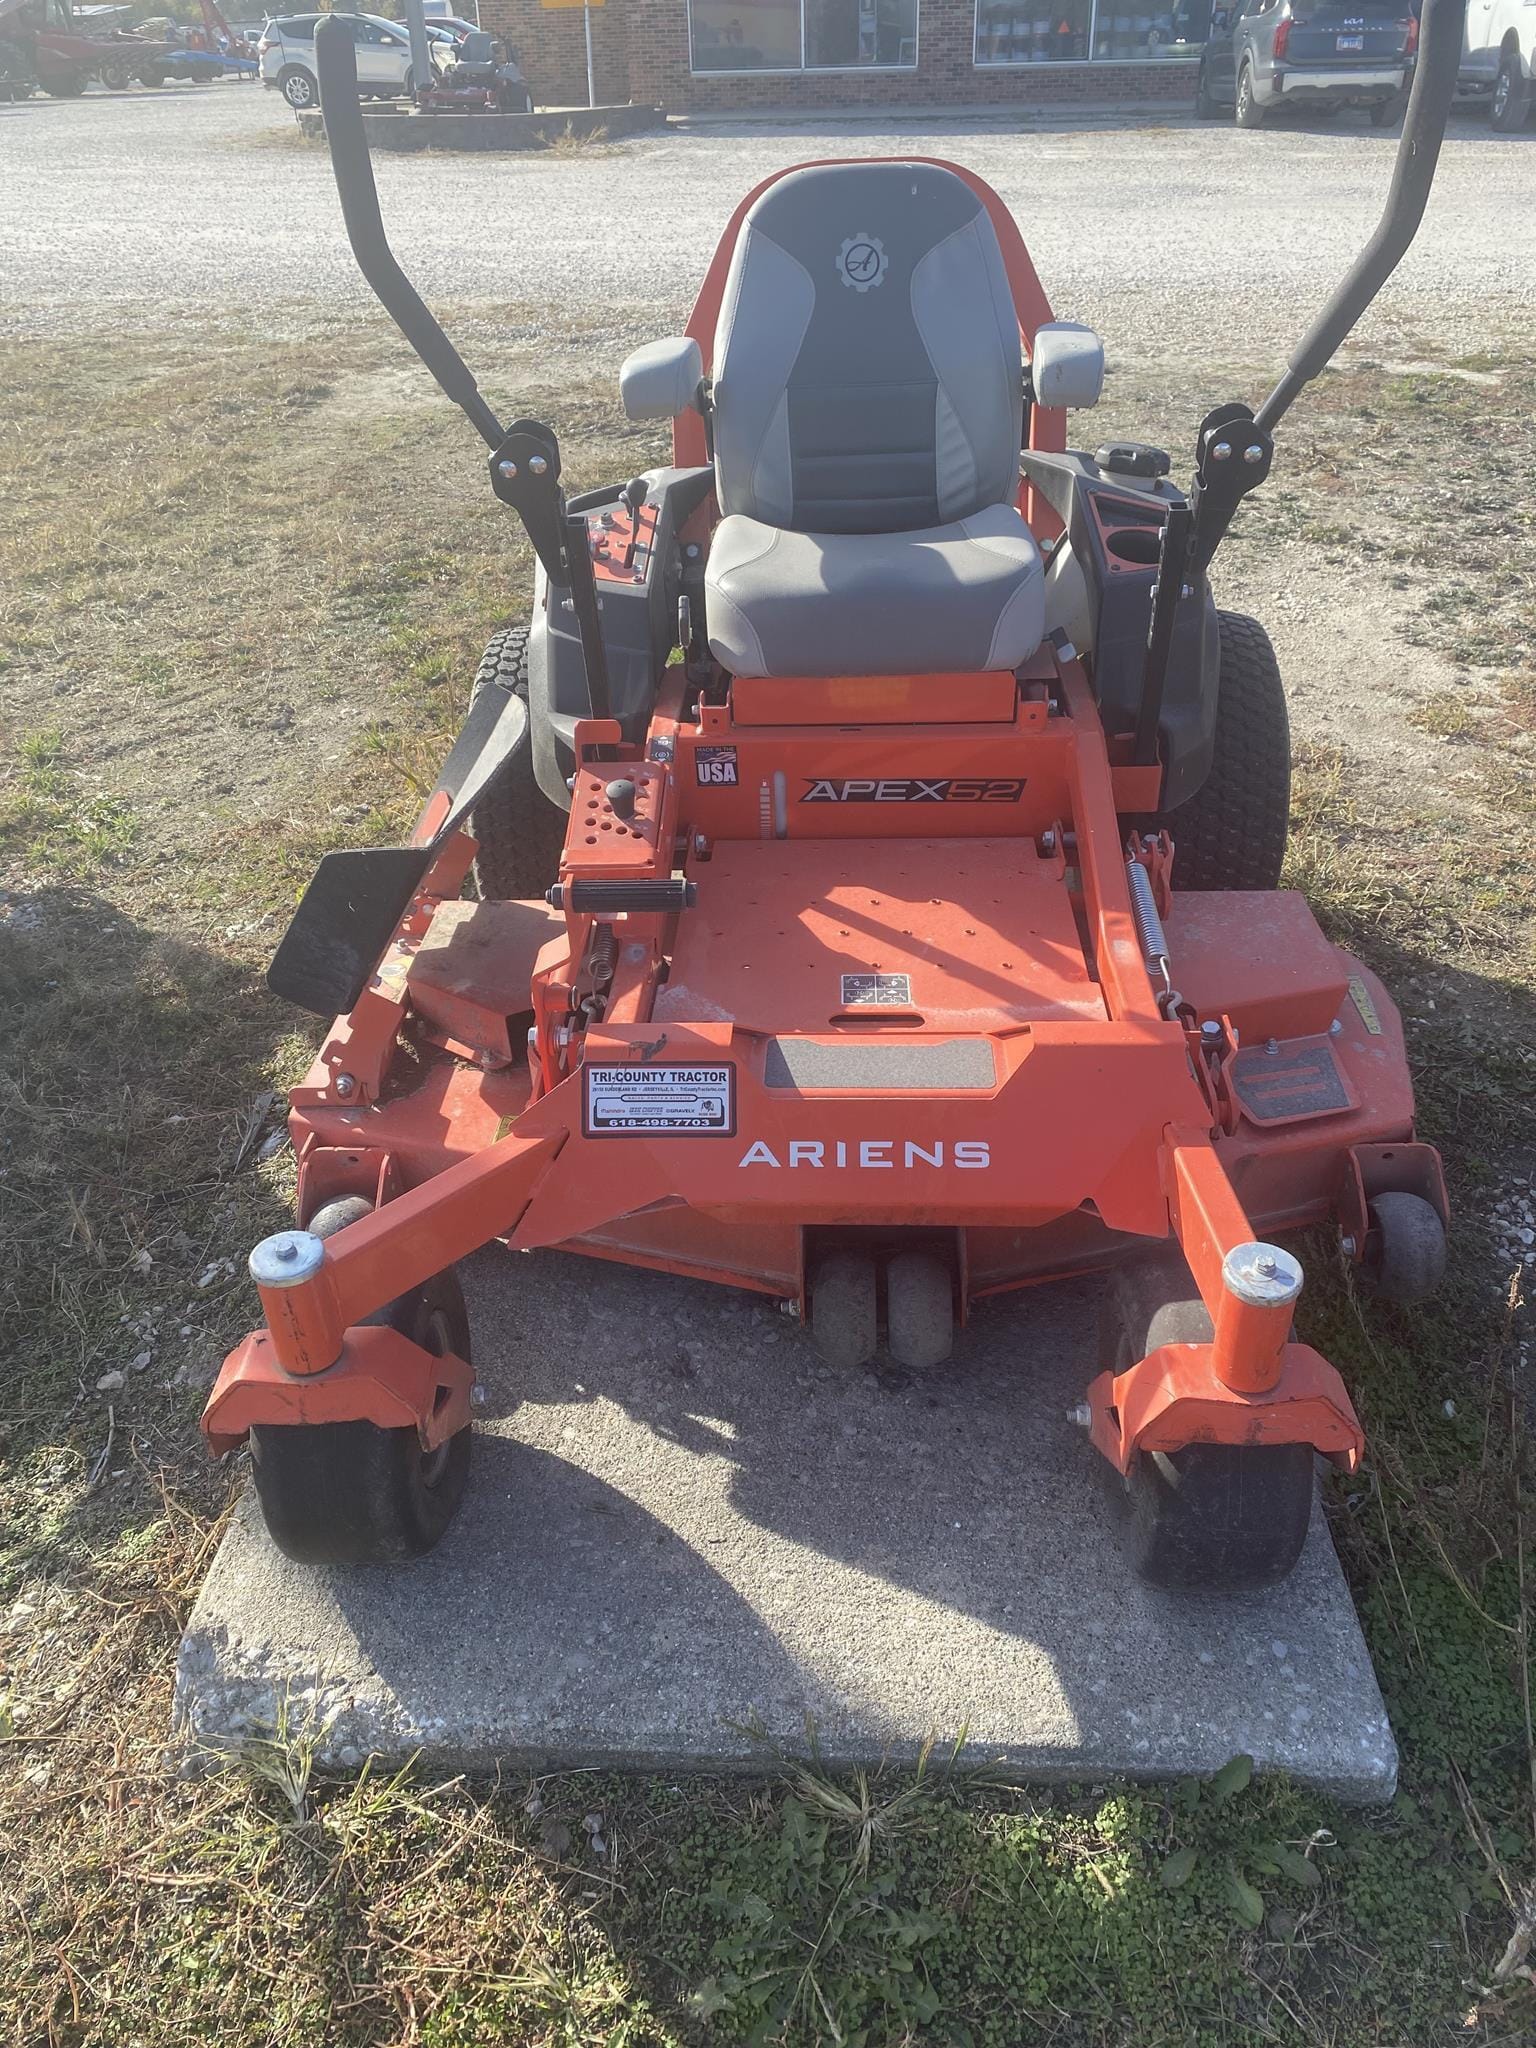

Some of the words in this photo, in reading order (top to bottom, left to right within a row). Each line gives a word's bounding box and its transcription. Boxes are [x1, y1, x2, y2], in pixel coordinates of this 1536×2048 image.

[697, 762, 737, 783] USA
[592, 1071, 667, 1082] TRI-COUNTY
[669, 1071, 727, 1082] TRACTOR
[608, 1118, 711, 1127] 618-498-7703
[738, 1140, 991, 1169] ARIENS
